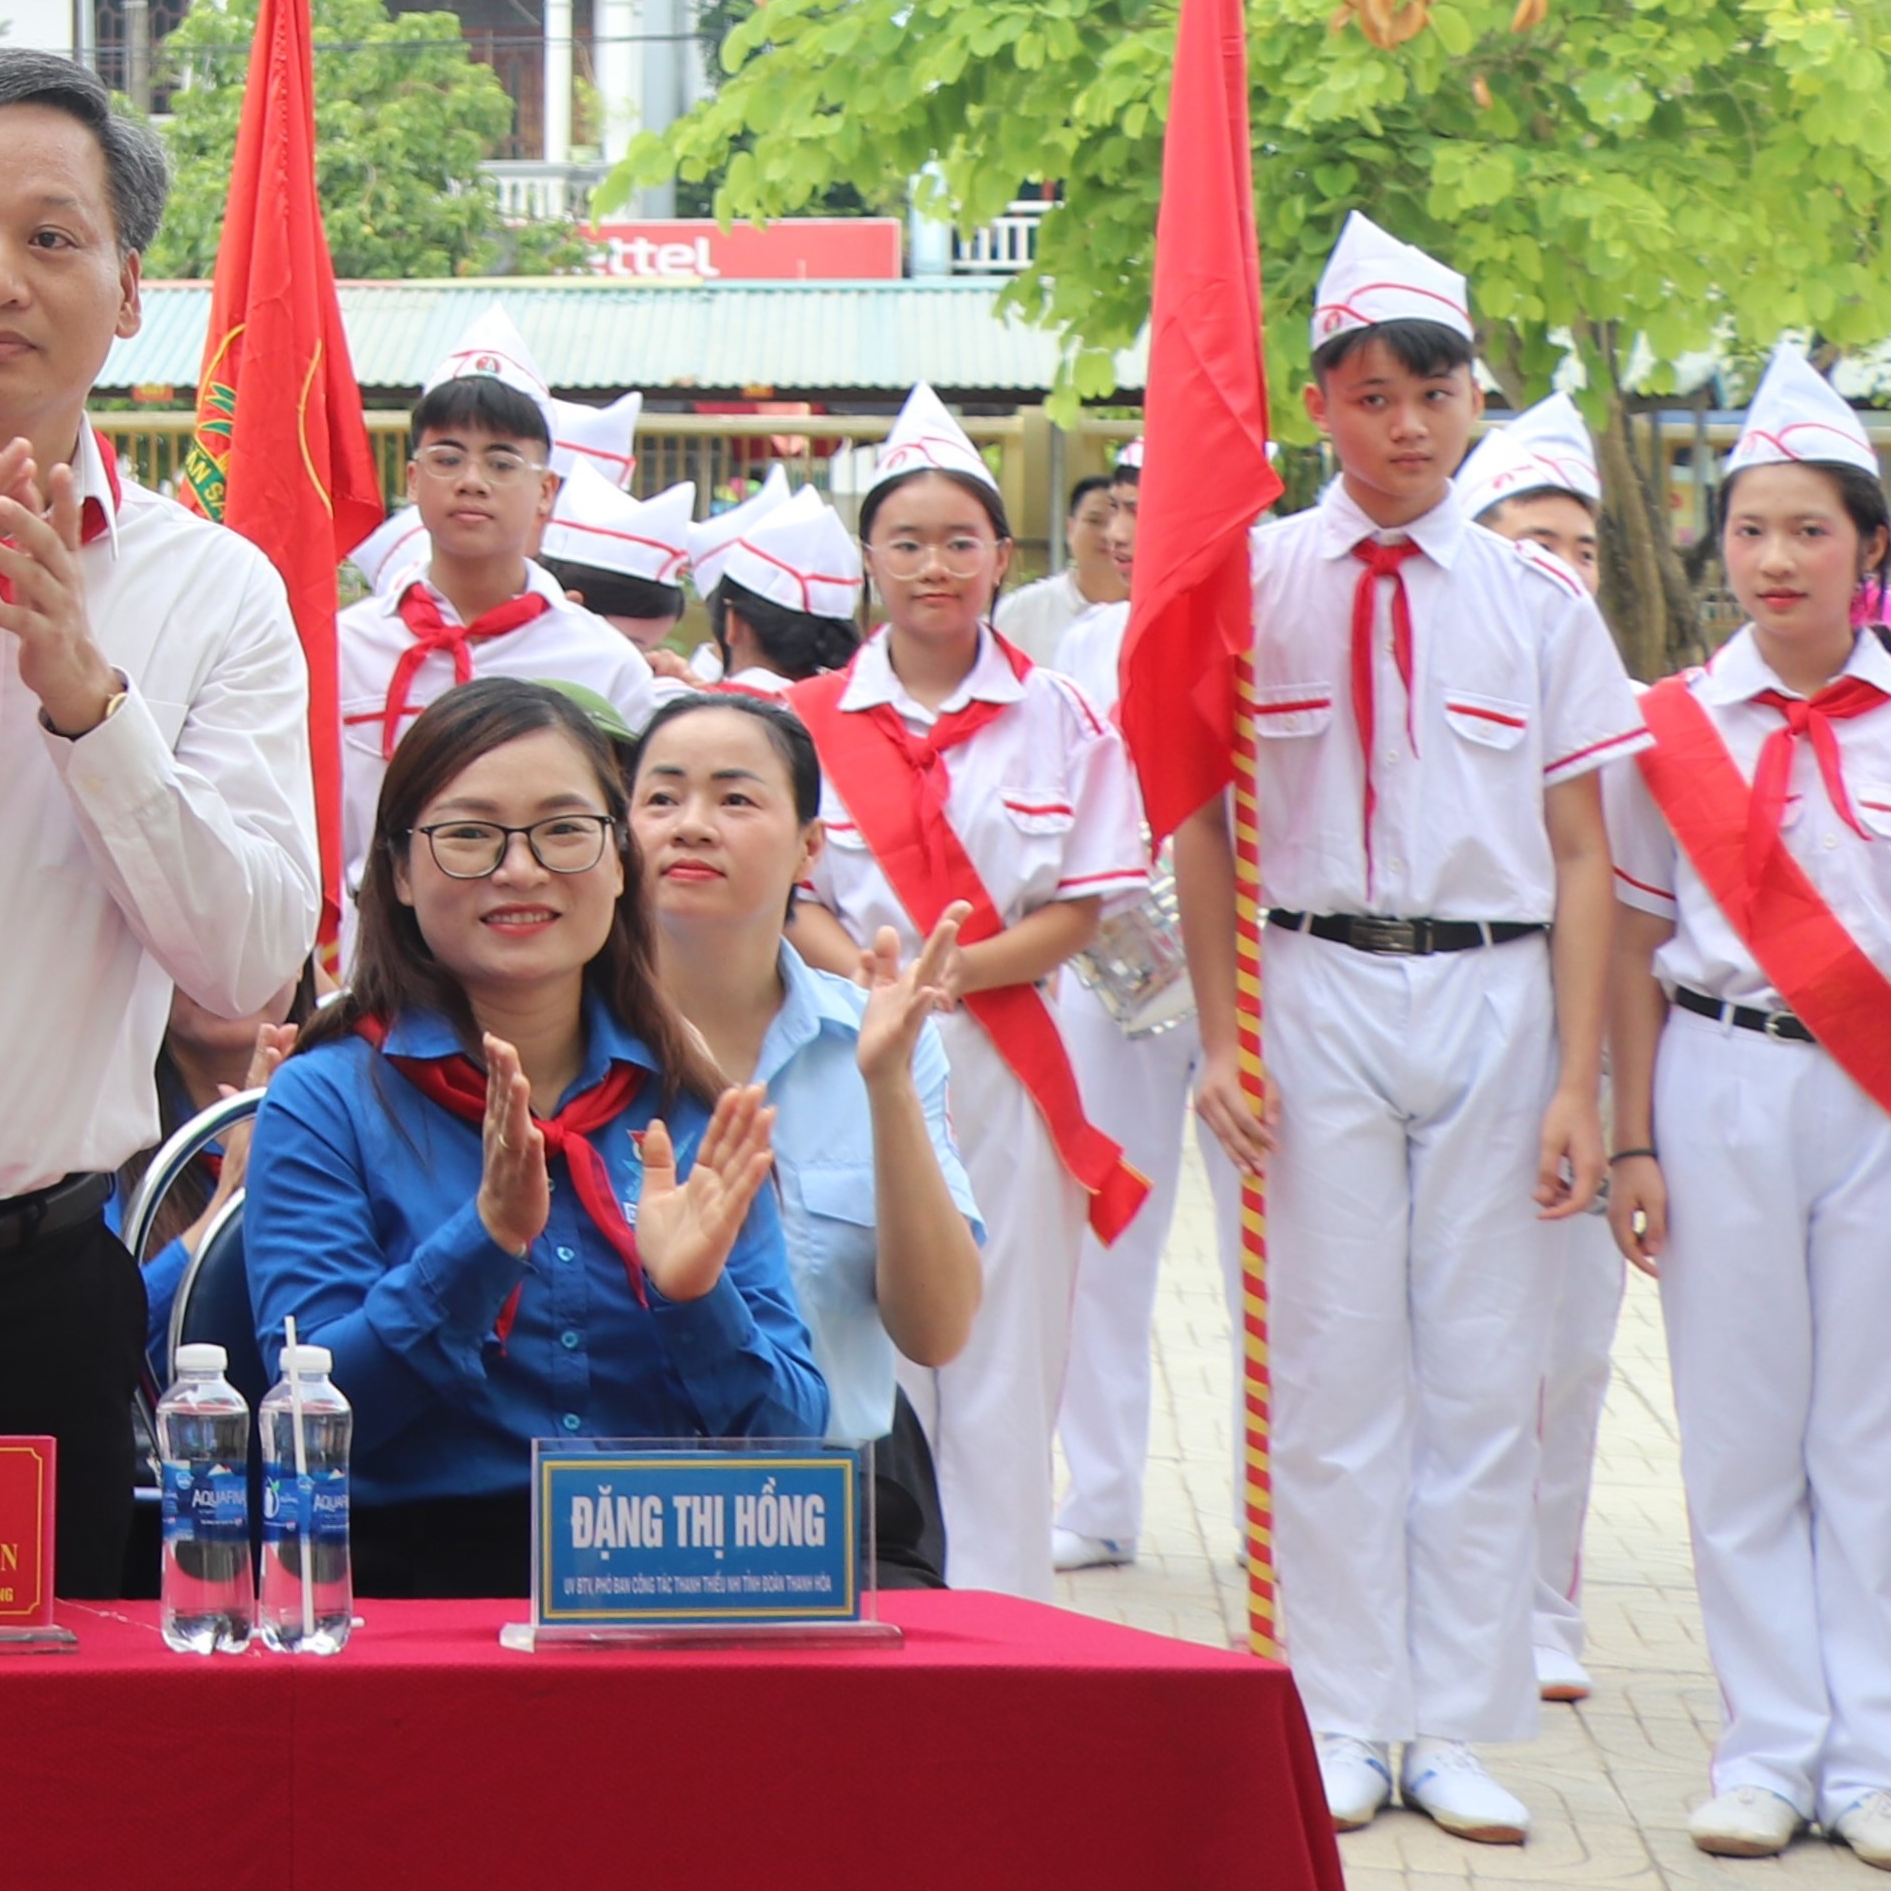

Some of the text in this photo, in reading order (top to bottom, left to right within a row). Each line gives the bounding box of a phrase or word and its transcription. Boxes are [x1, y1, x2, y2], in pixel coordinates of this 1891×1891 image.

[583, 235, 720, 276] ttel
[571, 1476, 826, 1560] ĐẶNG THỊ HỒNG
